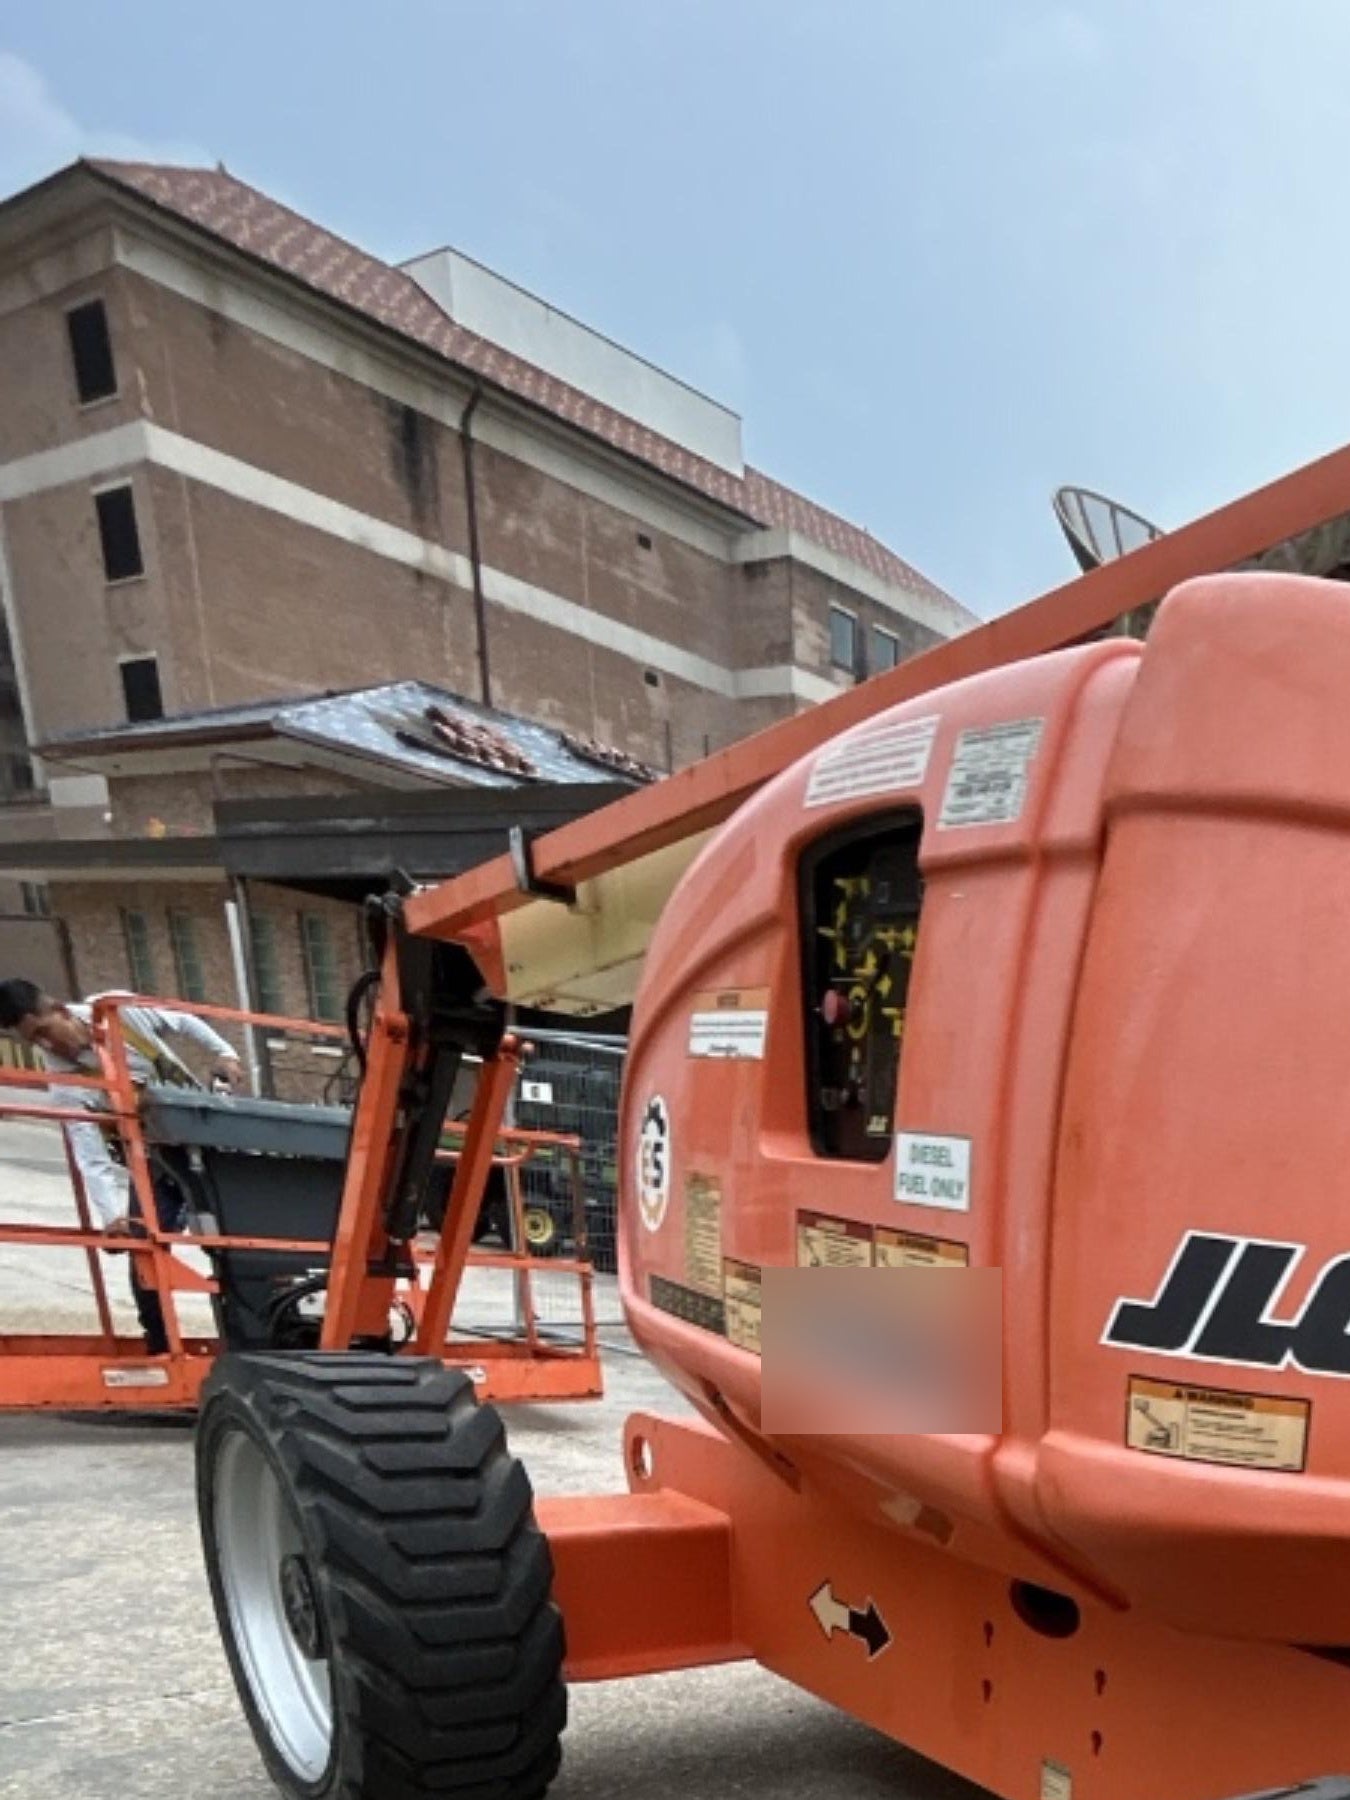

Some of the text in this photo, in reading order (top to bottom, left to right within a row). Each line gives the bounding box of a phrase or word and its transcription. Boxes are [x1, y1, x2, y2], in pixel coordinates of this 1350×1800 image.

[909, 1143, 954, 1168] DIESEL
[898, 1173, 964, 1200] FUEL ONLY
